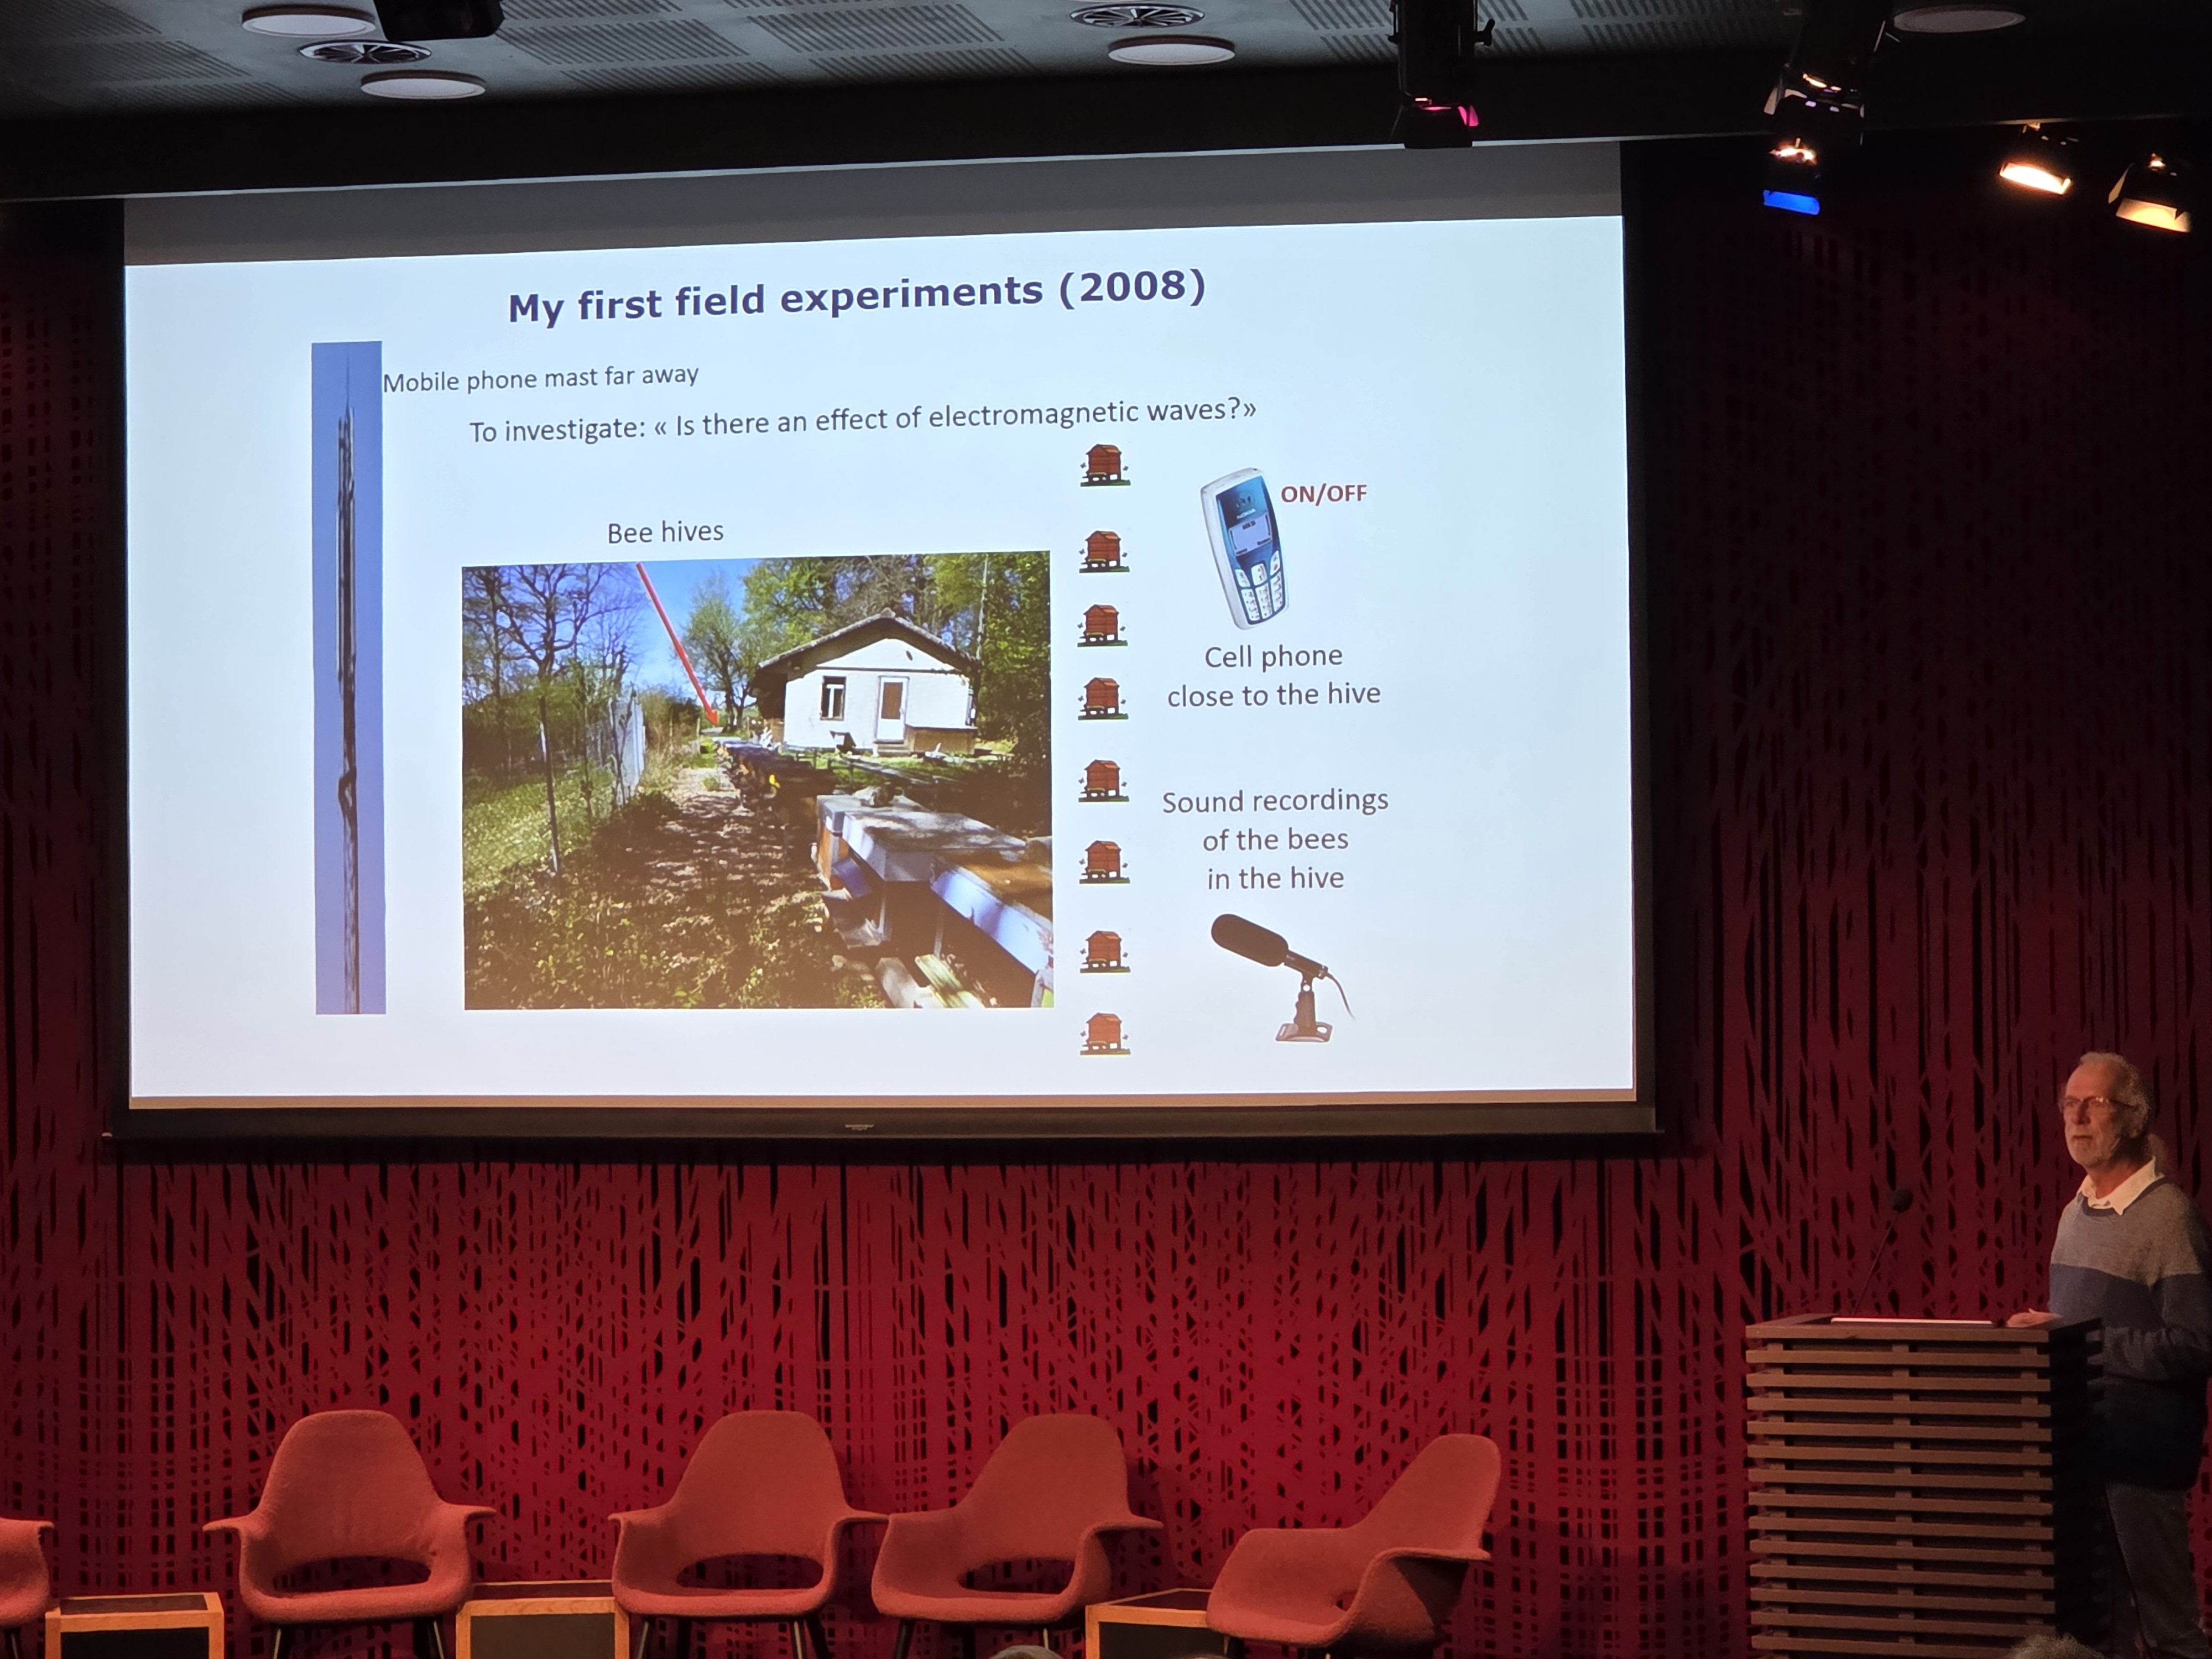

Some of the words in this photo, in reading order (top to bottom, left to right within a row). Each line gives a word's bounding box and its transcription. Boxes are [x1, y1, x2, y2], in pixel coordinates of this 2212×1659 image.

[510, 294, 565, 329] My
[578, 290, 662, 320] first
[675, 284, 764, 316] field
[781, 276, 1043, 319] experiments
[1060, 268, 1205, 310] (2008)
[384, 371, 460, 393] Mobile
[467, 370, 538, 395] phone
[545, 368, 598, 388] mast
[604, 366, 635, 386] far
[642, 368, 699, 387] away
[469, 421, 497, 443] To
[505, 418, 645, 445] investigate:
[677, 415, 695, 436] Is
[702, 412, 769, 435] there
[778, 415, 807, 432] an
[816, 408, 888, 431] effect
[896, 405, 922, 429] of
[929, 400, 1139, 429] electromagnetic
[1146, 397, 1256, 421] waves?»
[1281, 483, 1368, 507] ON/OFF
[608, 523, 653, 544] Bee
[662, 519, 724, 542] hives
[1205, 644, 1251, 668] Cell
[1262, 644, 1343, 673] phone
[1168, 684, 1234, 707] close
[1241, 686, 1269, 706] to
[1276, 682, 1319, 706] the
[1328, 681, 1381, 705] hive
[1163, 789, 1243, 813] Sound
[1254, 787, 1389, 816] recordings
[1203, 828, 1230, 852] of
[1236, 828, 1279, 851] the
[1288, 826, 1349, 850] bees
[1208, 868, 1229, 890] in
[1238, 866, 1281, 889] the
[1291, 865, 1344, 889] hive
